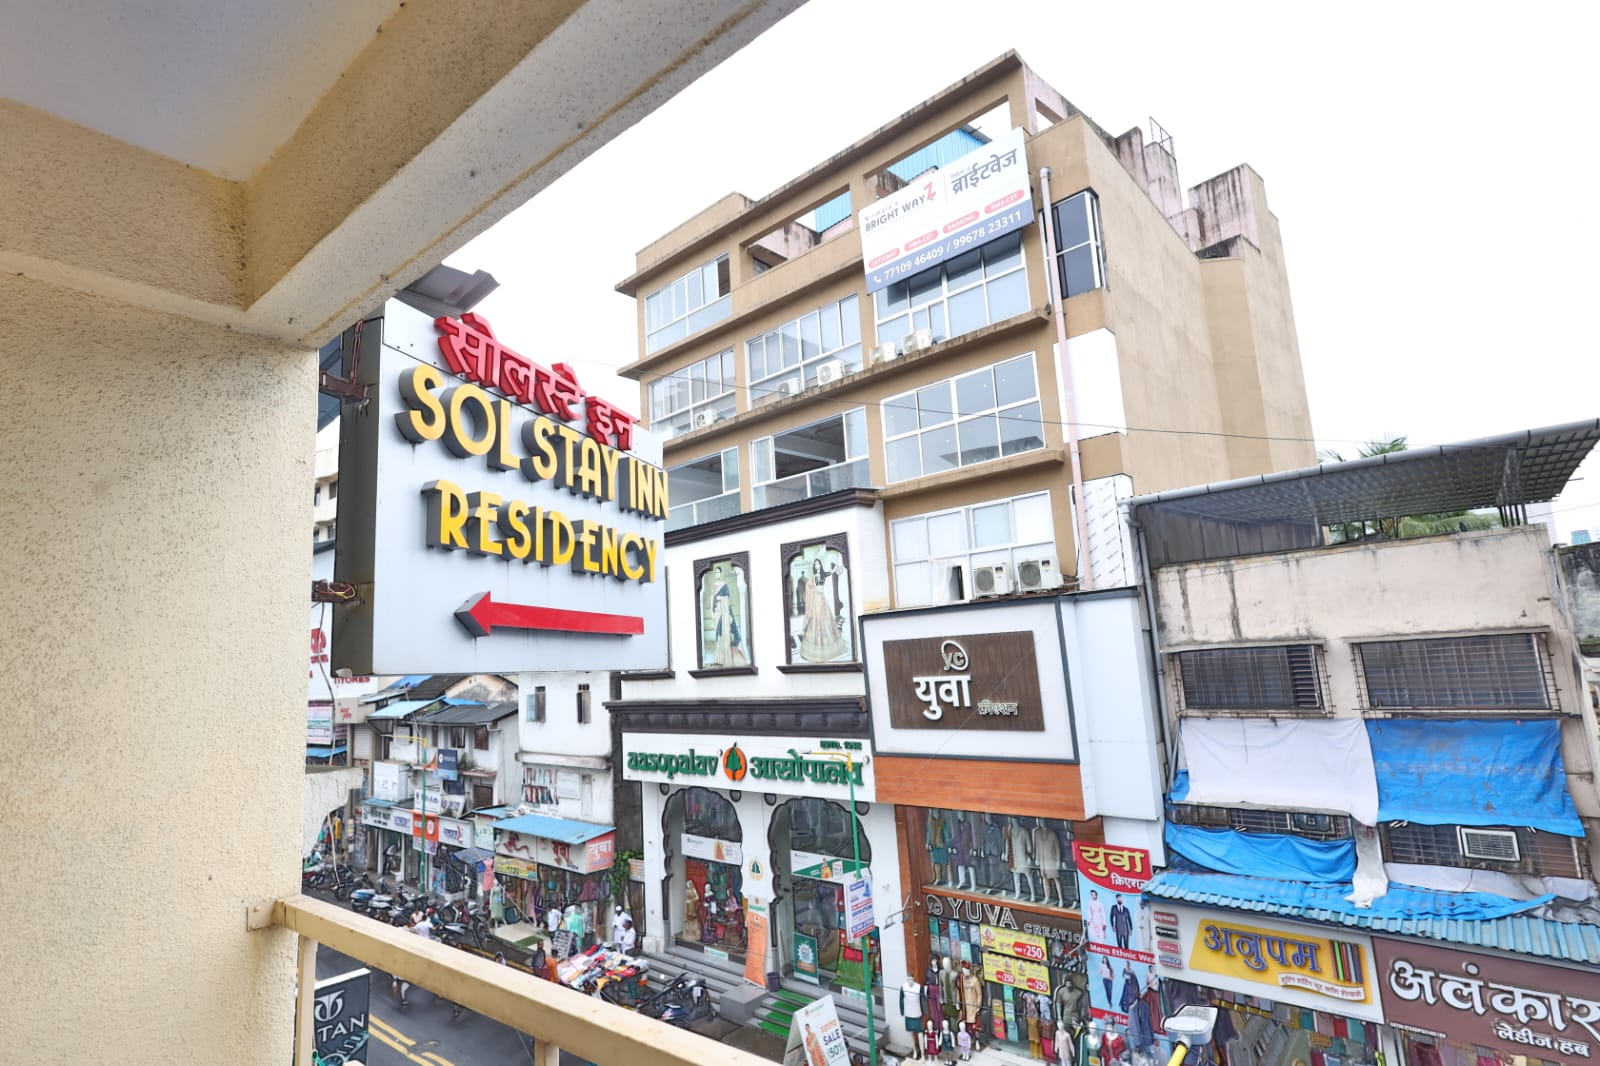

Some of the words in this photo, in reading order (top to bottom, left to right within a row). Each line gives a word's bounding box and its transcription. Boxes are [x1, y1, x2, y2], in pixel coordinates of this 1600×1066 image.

[951, 148, 1017, 194] ब्राईटवेज
[865, 207, 899, 232] BRIGHT
[884, 261, 912, 280] 77109
[915, 246, 943, 265] 46409
[953, 227, 985, 249] 99678
[988, 210, 1021, 233] 23311
[402, 364, 520, 471] SOL
[526, 416, 621, 502] STAY
[624, 457, 670, 520] INN
[586, 396, 640, 450] इन
[428, 480, 658, 584] RESIDENCY
[913, 675, 971, 720] युवा
[628, 748, 719, 779] aasopalav
[750, 749, 864, 786] आसोपालव
[1079, 846, 1145, 877] युवा
[947, 897, 1018, 930] YUVA
[1023, 923, 1083, 944] CREATIO
[1090, 944, 1111, 955] Mens
[1112, 948, 1136, 959] Ethnic
[1138, 953, 1154, 963] Wea
[1203, 925, 1321, 972] अनुपम
[1390, 960, 1600, 1042] अलंकार
[317, 1013, 365, 1042] TAN
[823, 1028, 841, 1046] SALE
[1496, 1022, 1553, 1049] लेडीज
